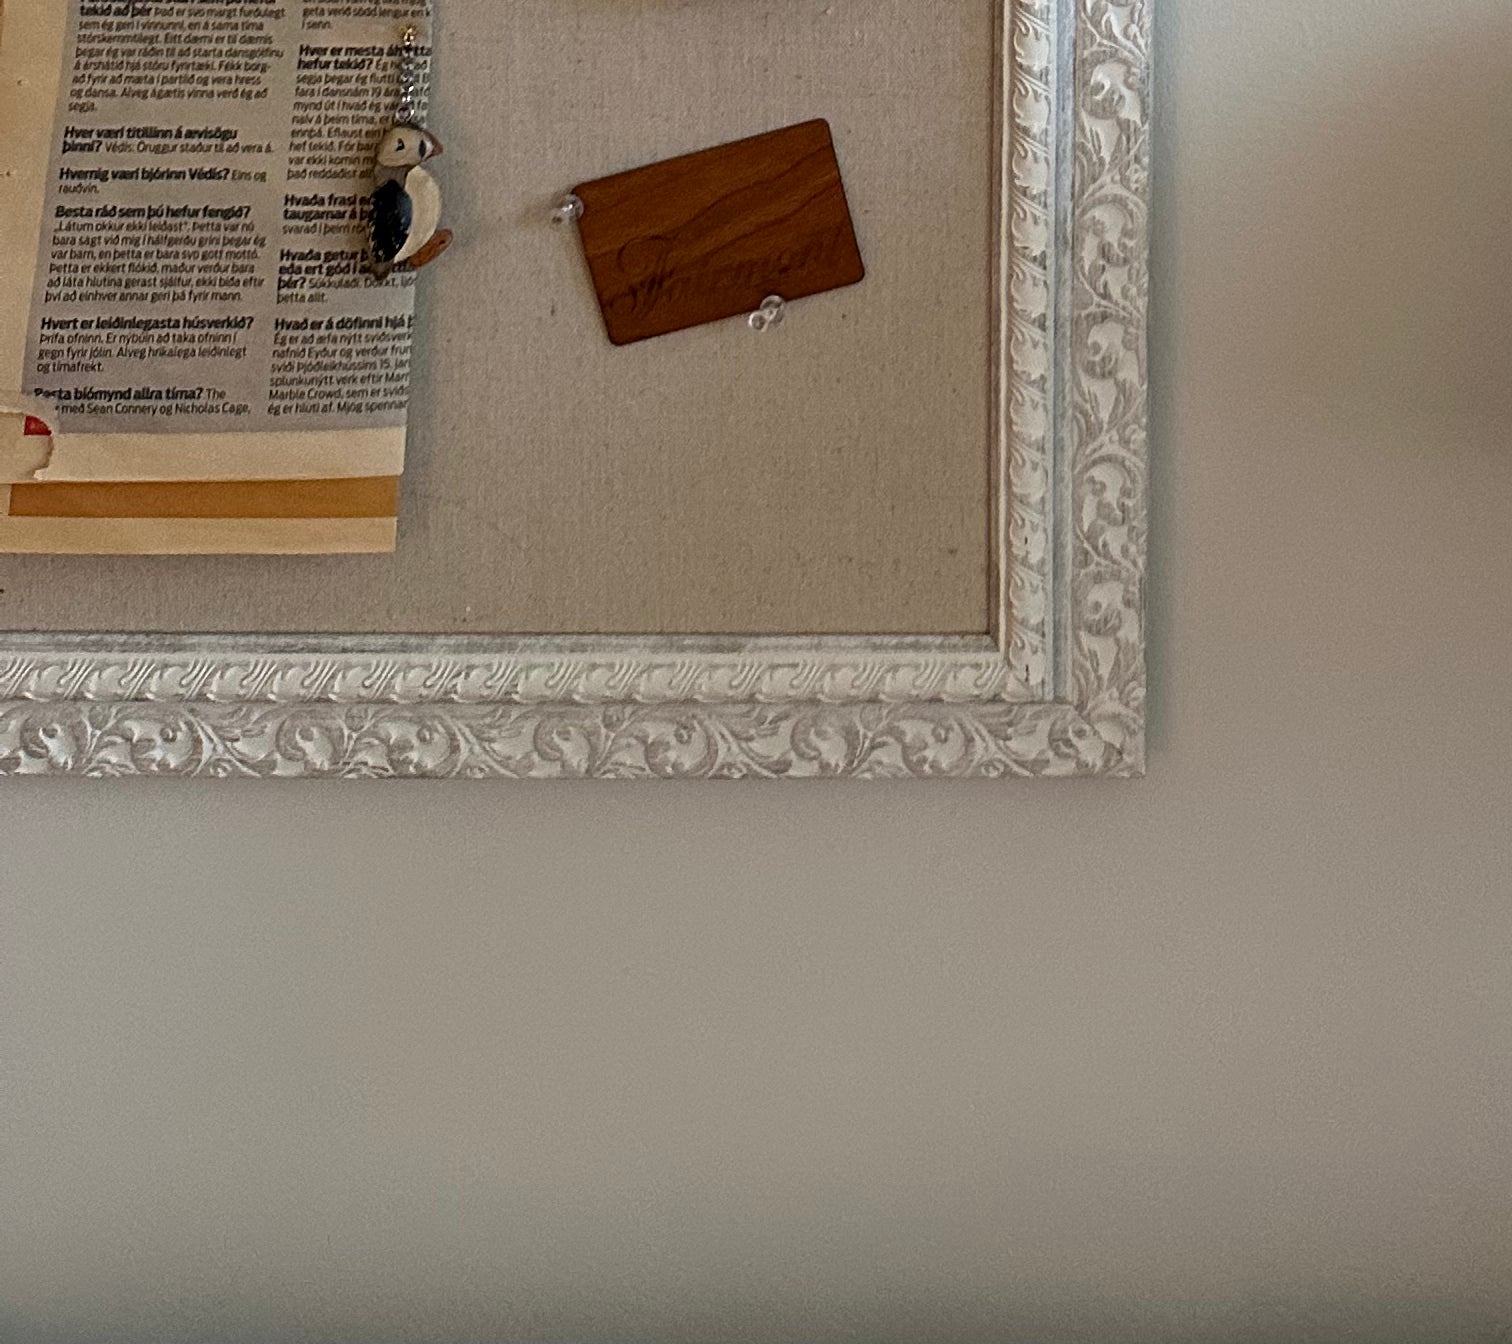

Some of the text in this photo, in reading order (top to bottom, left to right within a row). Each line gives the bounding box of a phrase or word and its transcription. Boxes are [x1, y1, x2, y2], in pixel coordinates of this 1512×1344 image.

[80, 4, 111, 16] tekið
[113, 5, 130, 17] að
[300, 45, 384, 57] Hver er mesta
[297, 58, 372, 70] hefur tekið?
[64, 127, 94, 139] Hver
[96, 127, 124, 139] væri
[175, 126, 183, 139] á
[185, 127, 237, 141] ævisögu
[62, 141, 102, 154] þinni?
[59, 167, 230, 182] Hvernig væri bjórinn Védís?
[284, 194, 357, 206] Hvaða frasi
[55, 205, 250, 220] Besta ráð sem þú hefur fengið?
[283, 208, 357, 221] taugarnar á
[280, 249, 359, 263] Hvaða getur
[41, 316, 254, 331] Hvert er leiðinlegasta húsverkið?
[274, 314, 405, 330] Hvað er á döfinni hjá
[67, 332, 103, 344] ofninn.
[106, 332, 117, 344] Er
[156, 332, 170, 344] að
[172, 332, 195, 344] taka
[197, 332, 231, 344] ofninn
[37, 347, 64, 360] gegn
[66, 346, 88, 360] fyrir
[116, 347, 145, 359] Alveg
[148, 346, 196, 359] hrikalega
[198, 346, 248, 359] leiðinlegt
[37, 360, 104, 374] og tímafrekt.
[74, 387, 131, 402] bíómynd
[133, 387, 163, 400] allra
[165, 387, 203, 400] tíma?
[206, 388, 226, 399] The
[61, 403, 84, 414] með
[87, 402, 112, 414] Sean
[115, 402, 157, 416] Connery
[159, 403, 173, 416] og
[175, 402, 220, 414] Nicholas
[221, 402, 251, 415] Cage,
